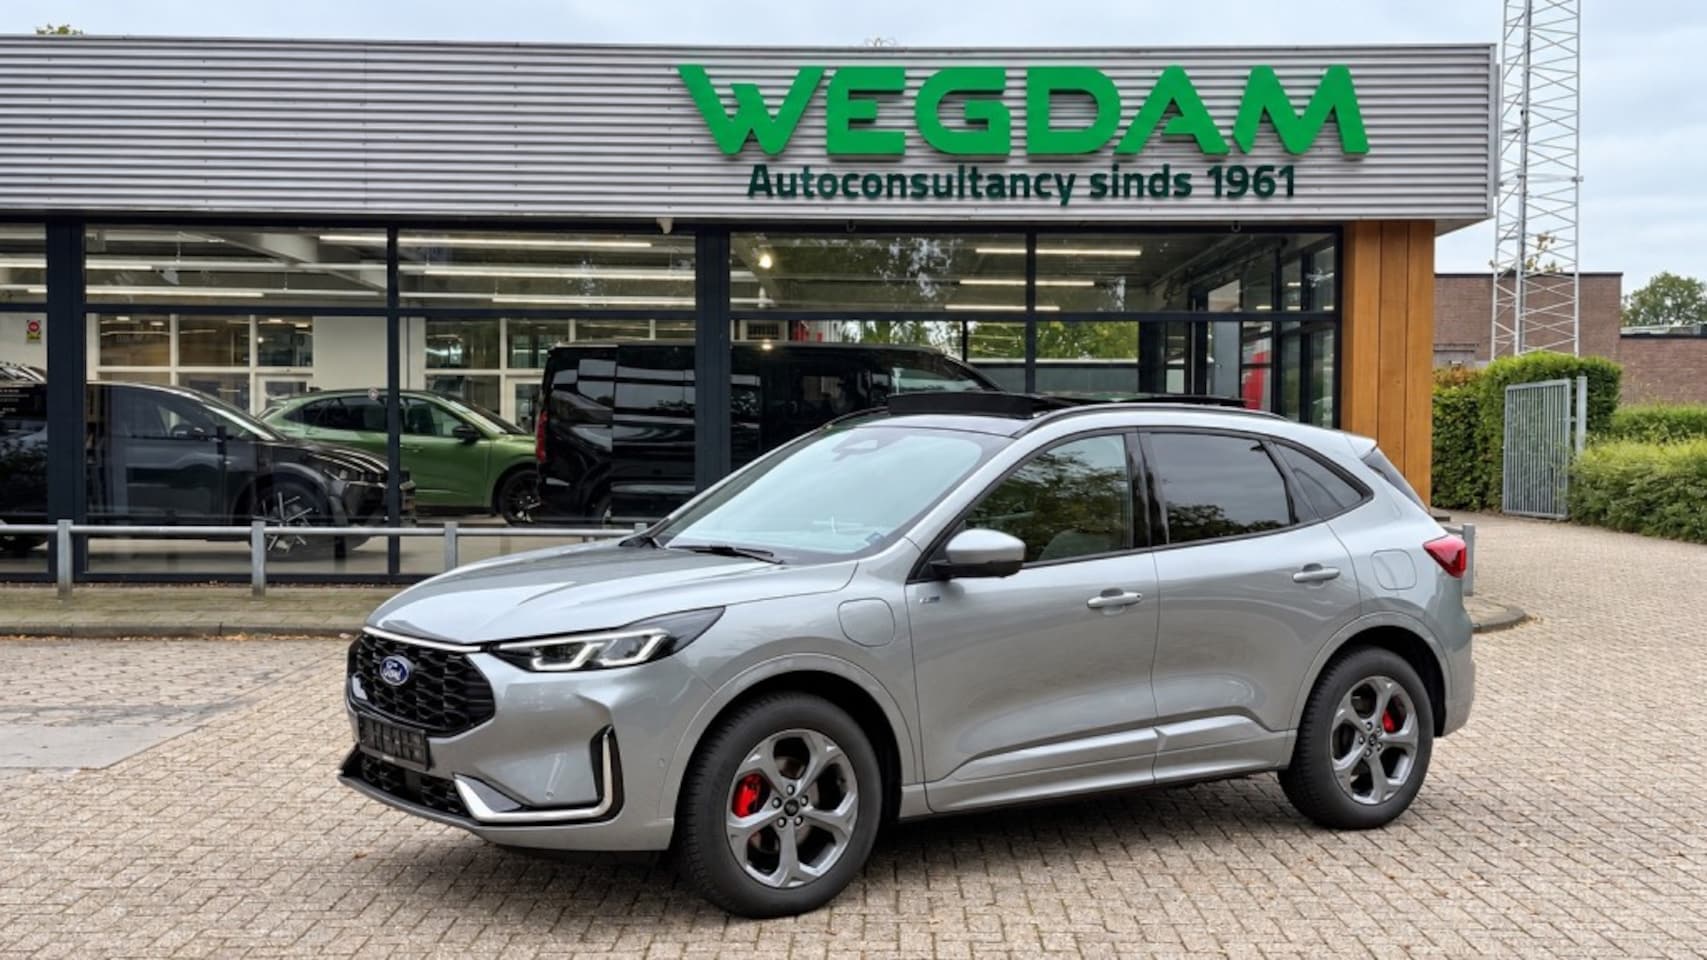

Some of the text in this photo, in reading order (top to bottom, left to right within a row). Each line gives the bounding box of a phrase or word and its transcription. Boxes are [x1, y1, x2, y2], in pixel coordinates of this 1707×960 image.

[678, 64, 1369, 156] WEGDAM
[748, 164, 1296, 205] Autoconsultancy sinds 1961
